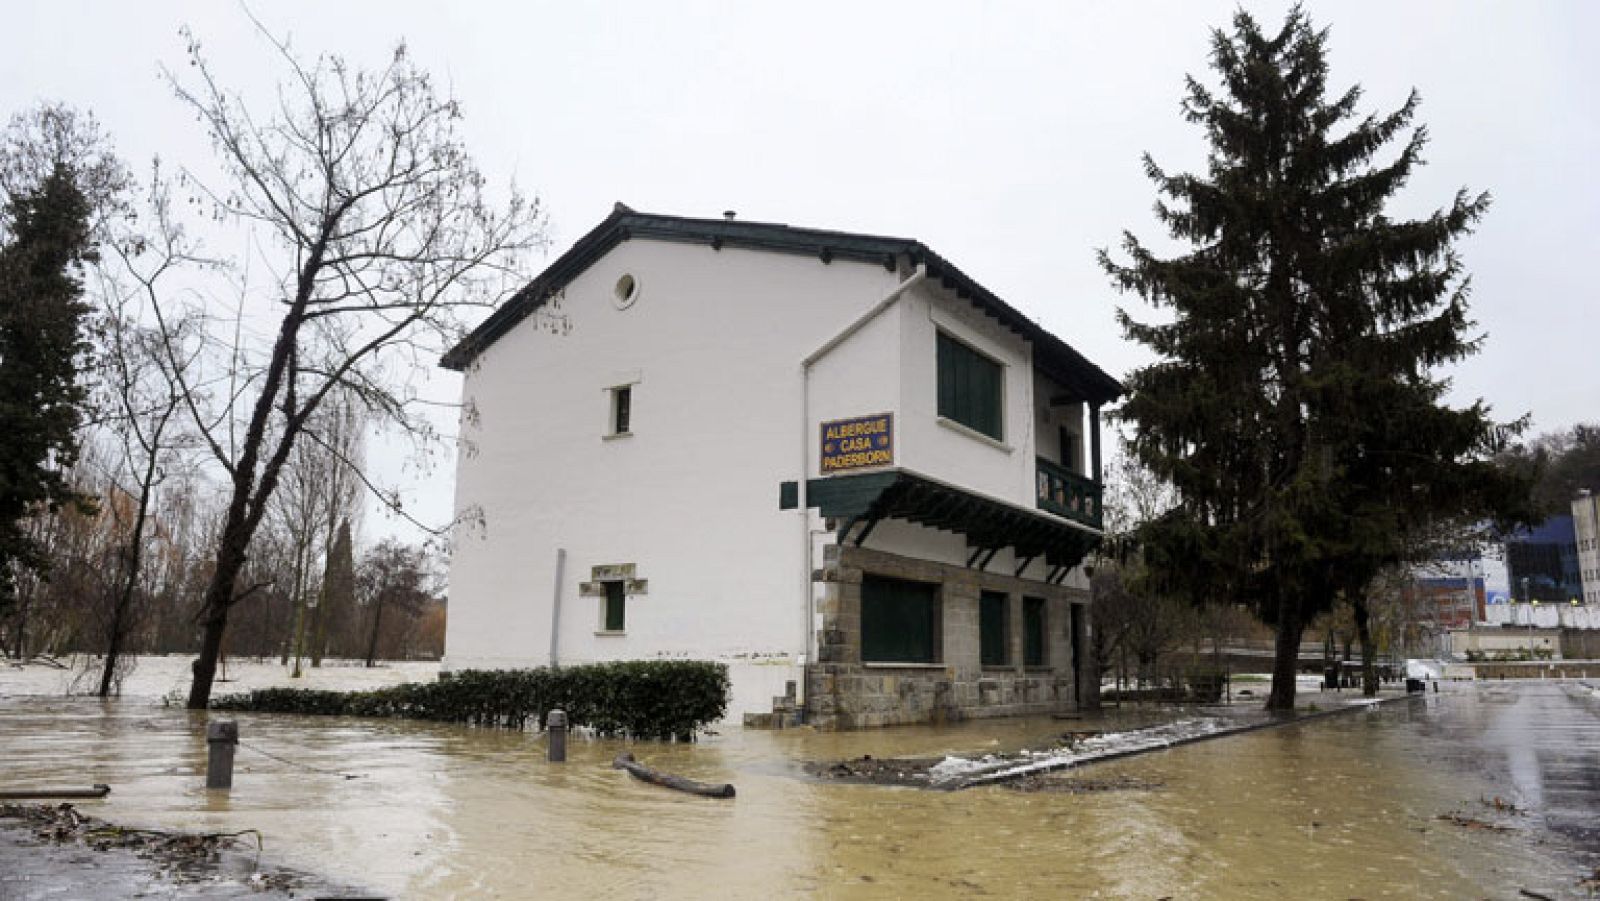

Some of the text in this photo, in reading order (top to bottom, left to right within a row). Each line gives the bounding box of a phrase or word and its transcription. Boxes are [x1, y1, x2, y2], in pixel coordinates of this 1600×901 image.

[827, 419, 886, 438] ALBERGUE
[841, 437, 871, 452] CASA
[824, 450, 890, 468] PADERBORN
